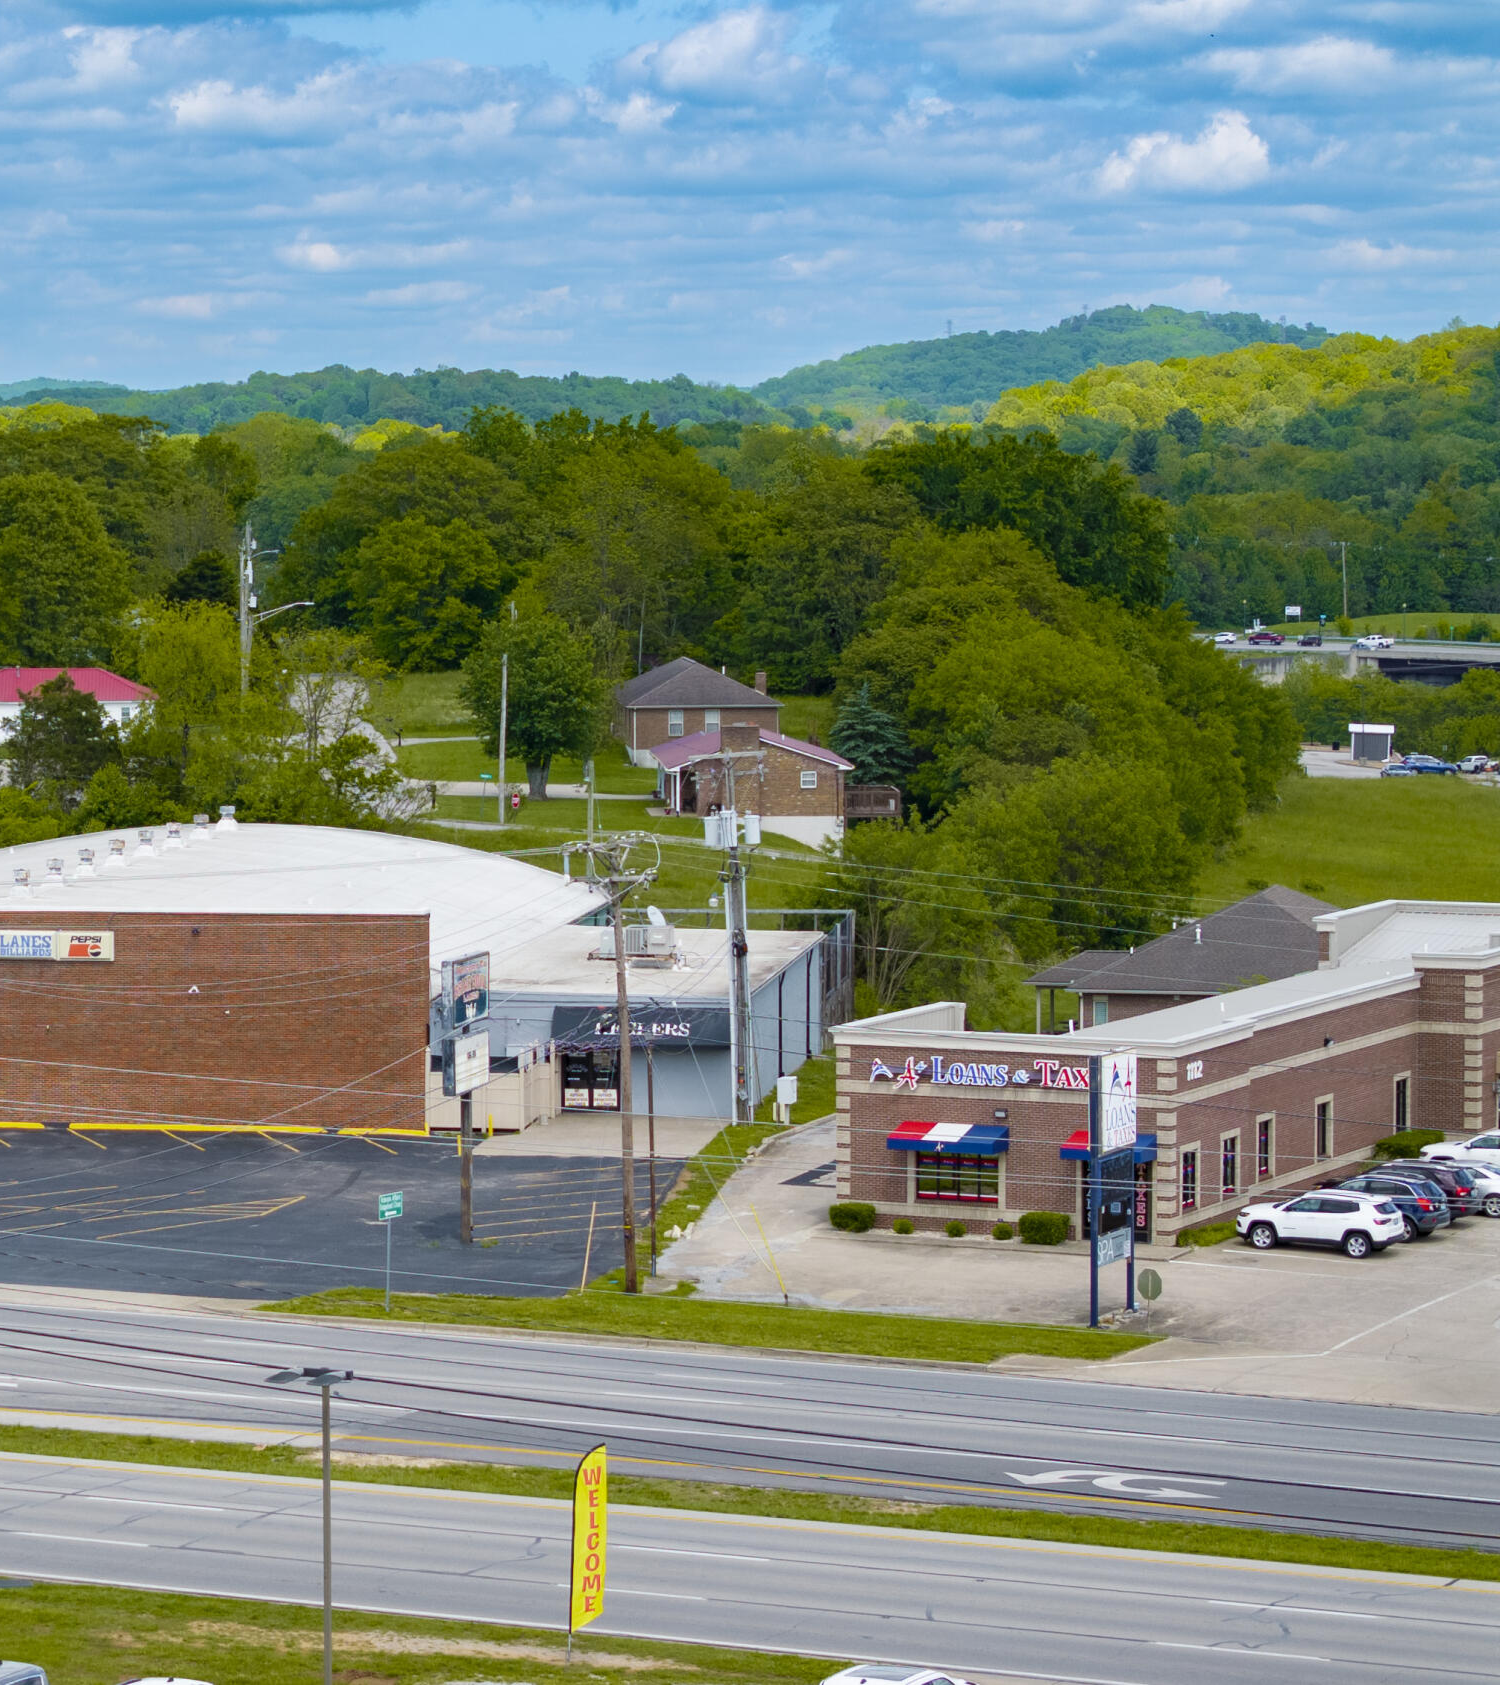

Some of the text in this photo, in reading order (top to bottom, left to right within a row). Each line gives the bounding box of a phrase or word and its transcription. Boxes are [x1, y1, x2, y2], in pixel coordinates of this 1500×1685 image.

[0, 935, 52, 948] LANES
[70, 935, 102, 943] PEPSI
[0, 947, 52, 957] BILLIARDS
[930, 1055, 1008, 1087] LOANS
[1012, 1069, 1030, 1084] &
[1186, 1060, 1203, 1081] 1112
[581, 1465, 602, 1613] WELCOME
